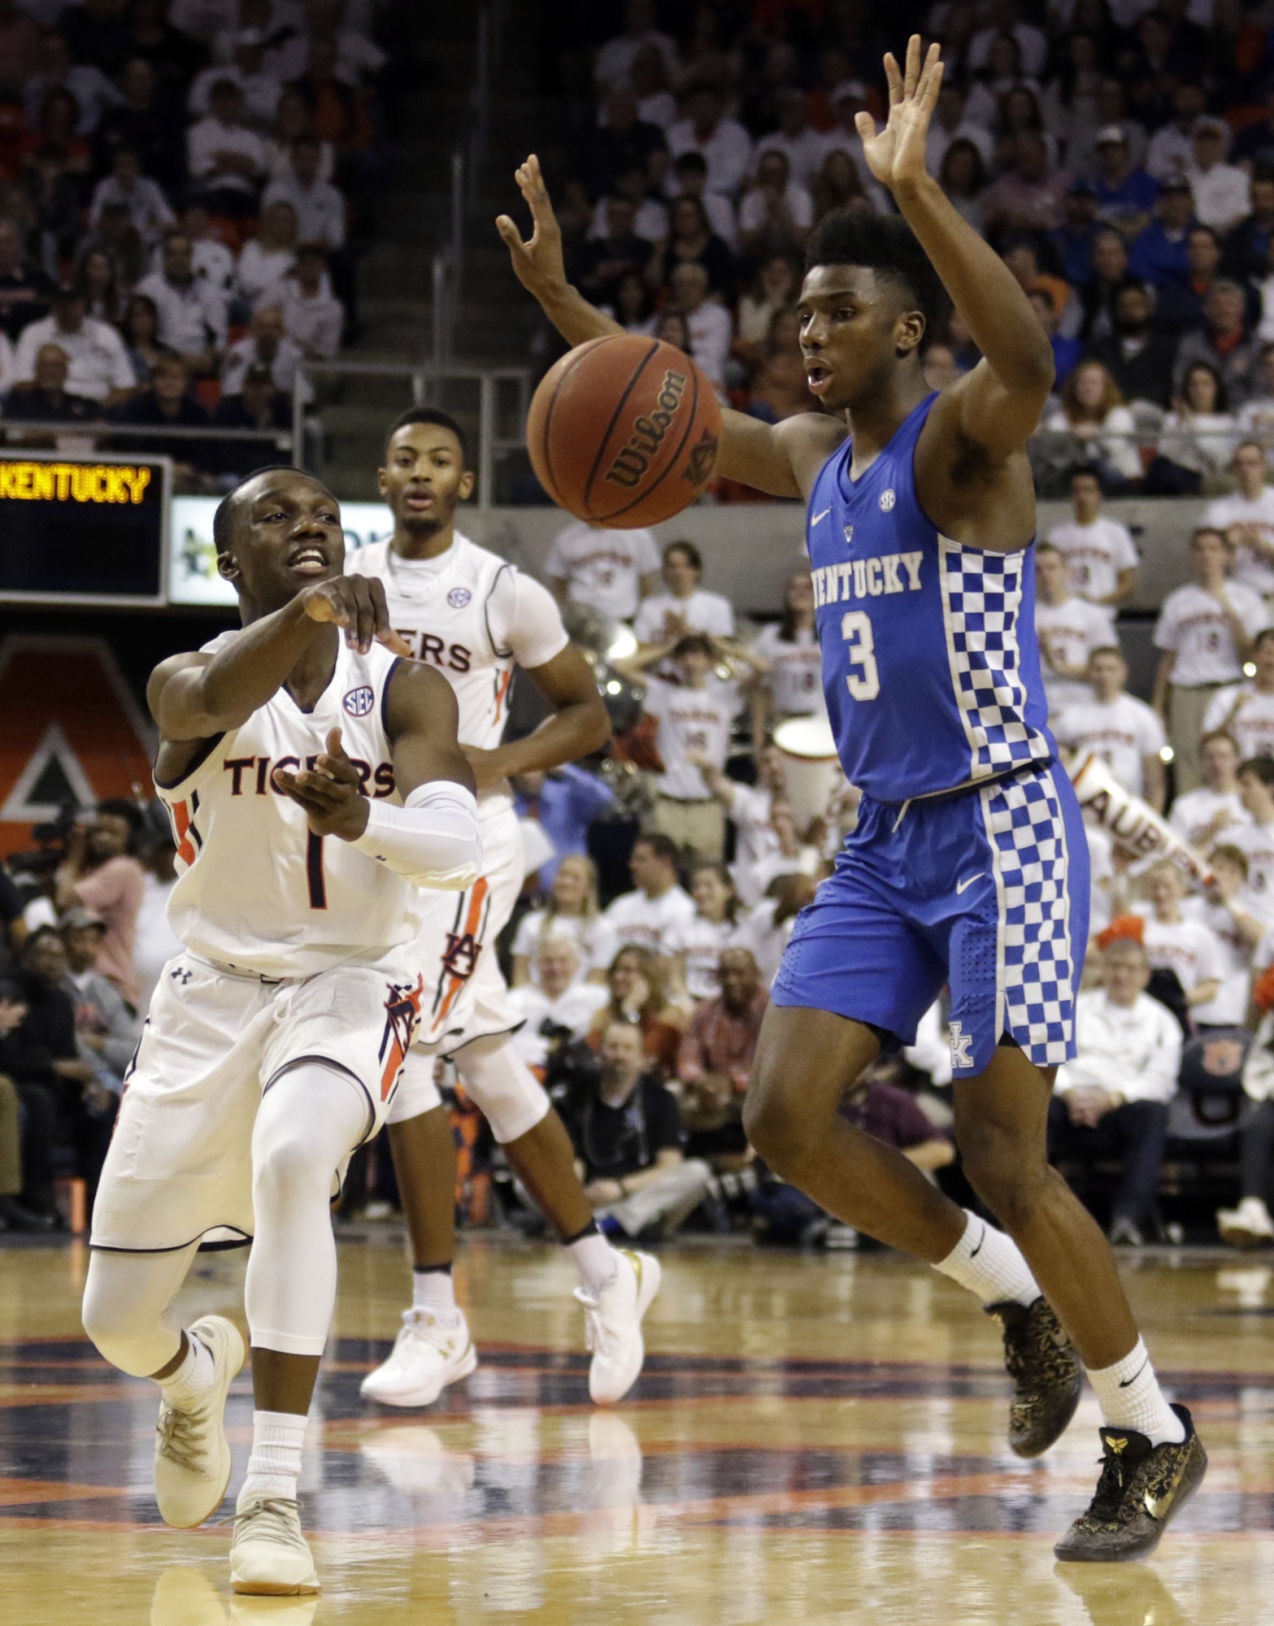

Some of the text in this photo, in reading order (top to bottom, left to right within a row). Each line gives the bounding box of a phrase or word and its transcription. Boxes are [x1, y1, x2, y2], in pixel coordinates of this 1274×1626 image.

[604, 369, 687, 488] Wilson
[0, 462, 151, 504] KENTUCKY
[841, 610, 881, 701] 3
[343, 687, 374, 716] SEC
[306, 825, 328, 910] 1
